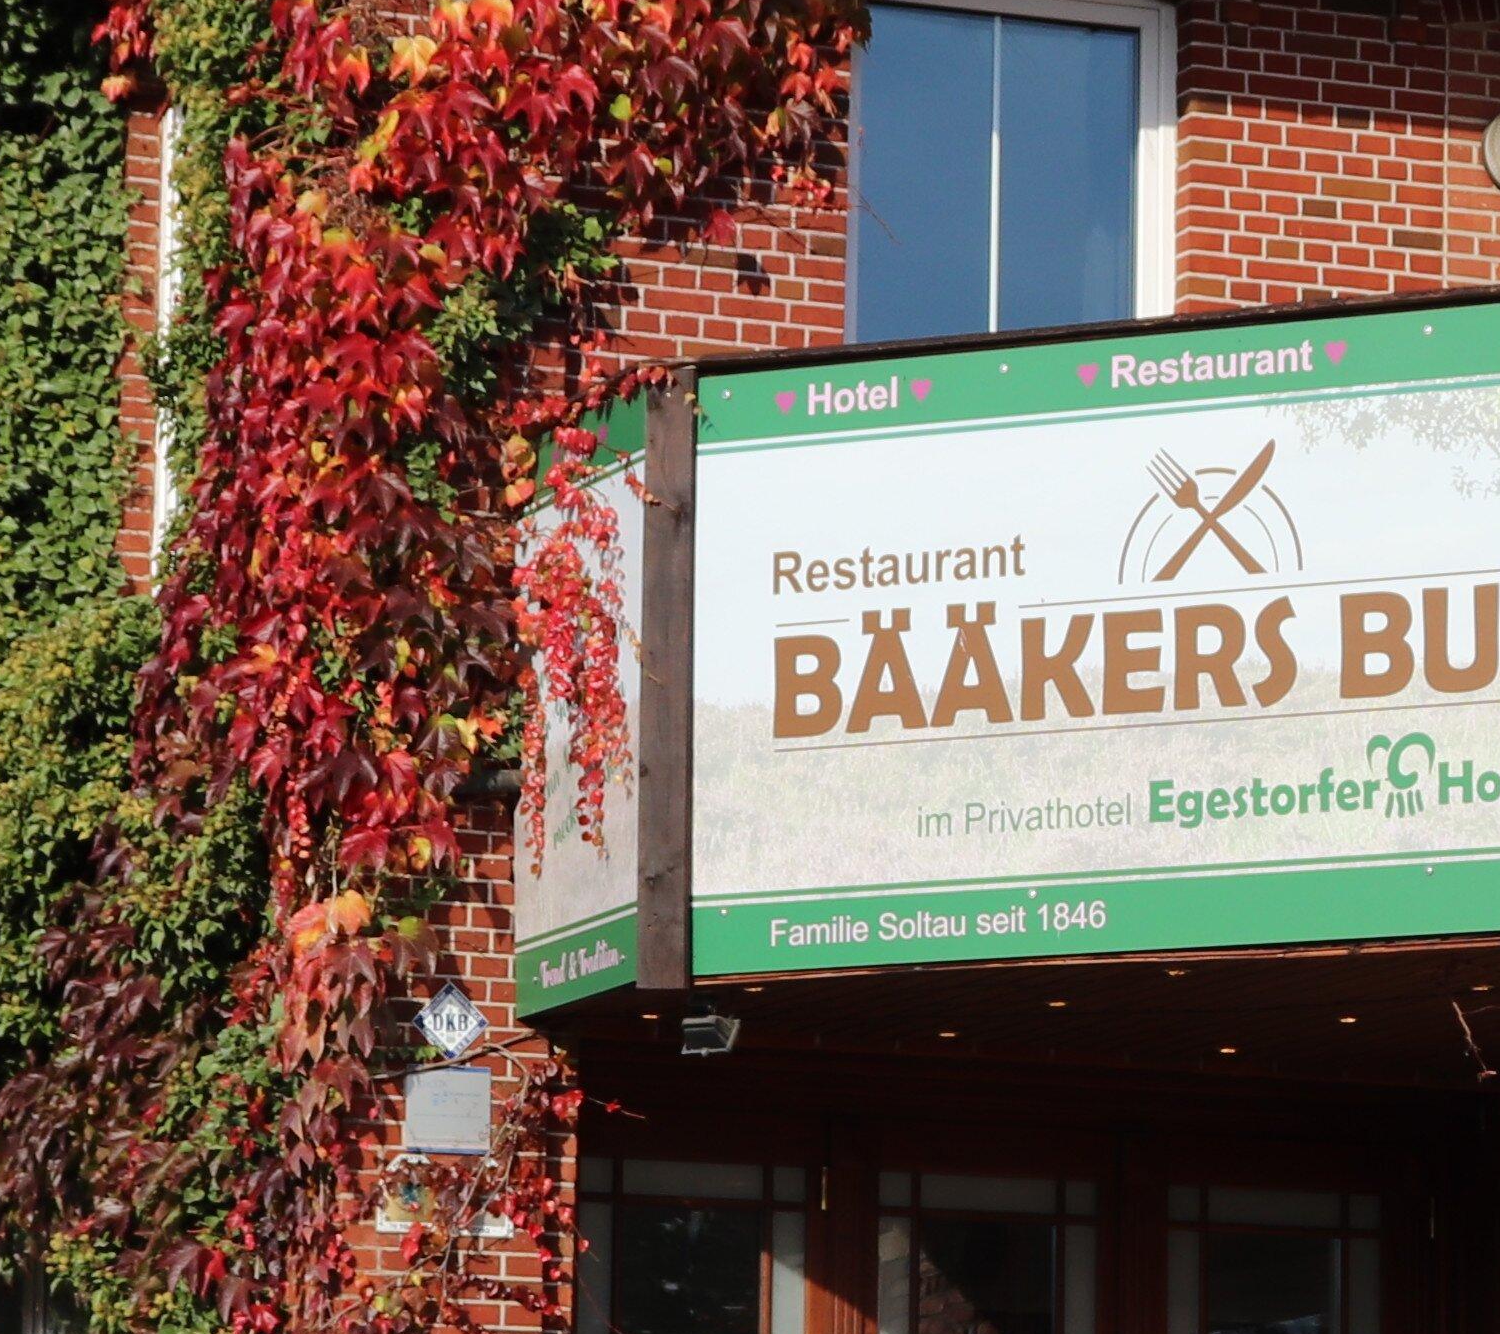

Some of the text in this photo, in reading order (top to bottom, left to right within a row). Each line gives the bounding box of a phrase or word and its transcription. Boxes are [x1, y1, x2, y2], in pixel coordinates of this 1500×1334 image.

[807, 375, 898, 416] Hotel
[1110, 339, 1313, 389] Restaurant
[772, 534, 1026, 595] Restaurant
[773, 595, 1298, 739] BÄÄKERS
[917, 806, 952, 838] im
[965, 792, 1132, 835] Privathotel
[1148, 767, 1382, 829] Egestorfer
[769, 900, 1107, 948] Familie Soltau seit 1846
[432, 1011, 469, 1033] DKB
